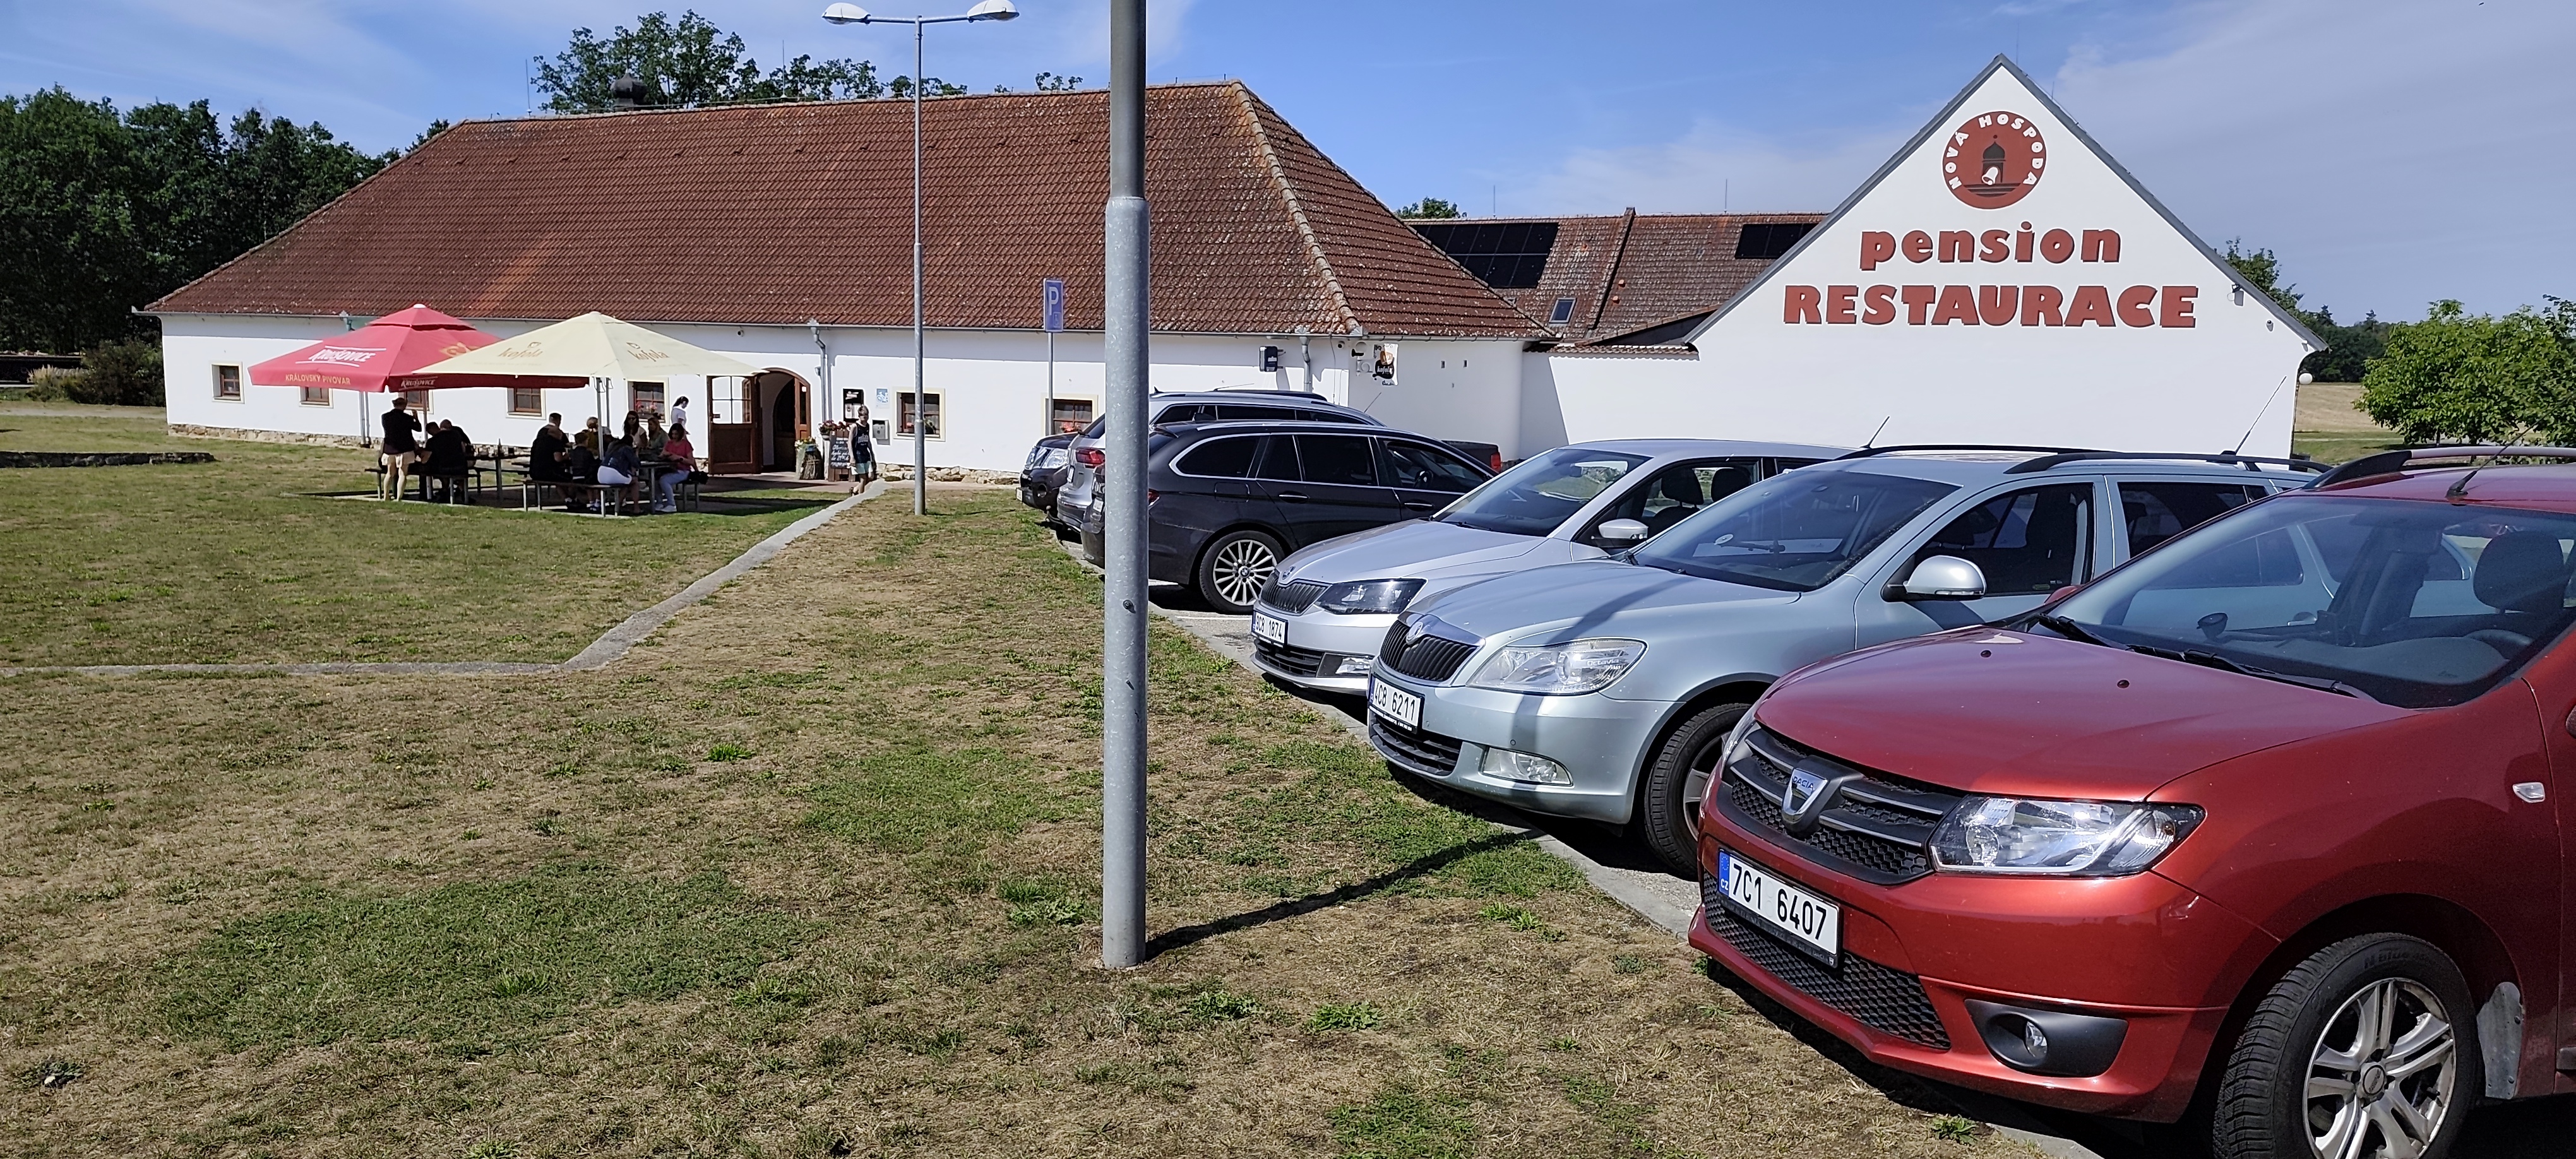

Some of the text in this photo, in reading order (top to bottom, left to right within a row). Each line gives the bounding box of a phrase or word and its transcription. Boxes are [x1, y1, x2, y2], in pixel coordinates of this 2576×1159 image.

[1945, 113, 2044, 190] NOVÁ HOSPODA
[1859, 221, 2121, 271] pension
[1049, 286, 1059, 316] P
[1783, 285, 2198, 328] RESTAURACE
[285, 372, 351, 384] KRÁLOVSKÝ PIVOVAR
[1256, 615, 1265, 633] 9C8
[1268, 619, 1282, 640] 1874
[1374, 682, 1387, 707] 4C8
[1392, 691, 1416, 721] 6211
[1792, 776, 1814, 790] DACIA
[1720, 878, 1729, 891] CZ
[1732, 863, 1762, 910] 7C1
[1777, 888, 1827, 941] 6407
